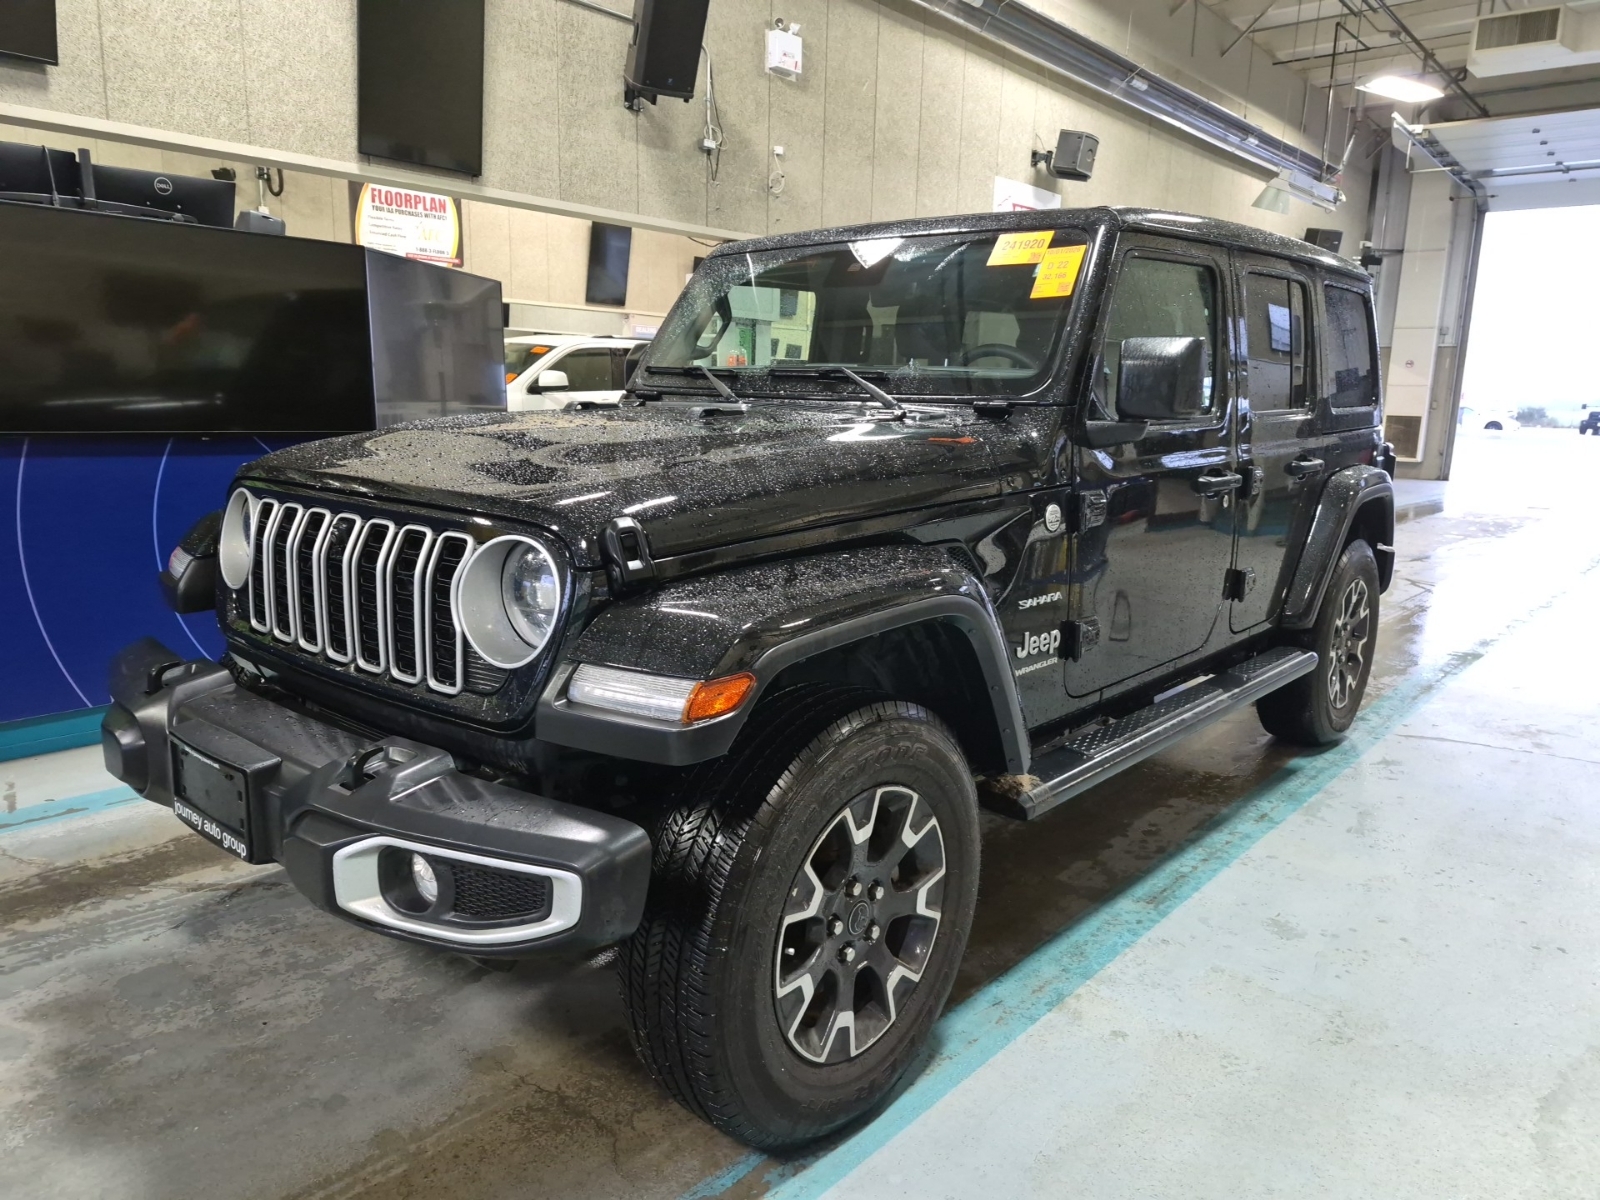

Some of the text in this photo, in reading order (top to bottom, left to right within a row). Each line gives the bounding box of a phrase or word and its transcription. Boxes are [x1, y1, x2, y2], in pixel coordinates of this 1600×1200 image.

[156, 182, 171, 190] DELL
[370, 187, 447, 214] FLOORPLAN
[371, 204, 386, 212] YOUR
[386, 206, 395, 214] IAA
[395, 207, 423, 218] PURCHASES
[424, 212, 437, 220] WITH
[1002, 239, 1045, 251] 241920
[1057, 260, 1069, 269] 22
[1018, 591, 1063, 610] SAHARA
[1016, 629, 1061, 659] Jeep
[1015, 656, 1058, 677] WRANGLER
[174, 797, 247, 858] journey auto group
